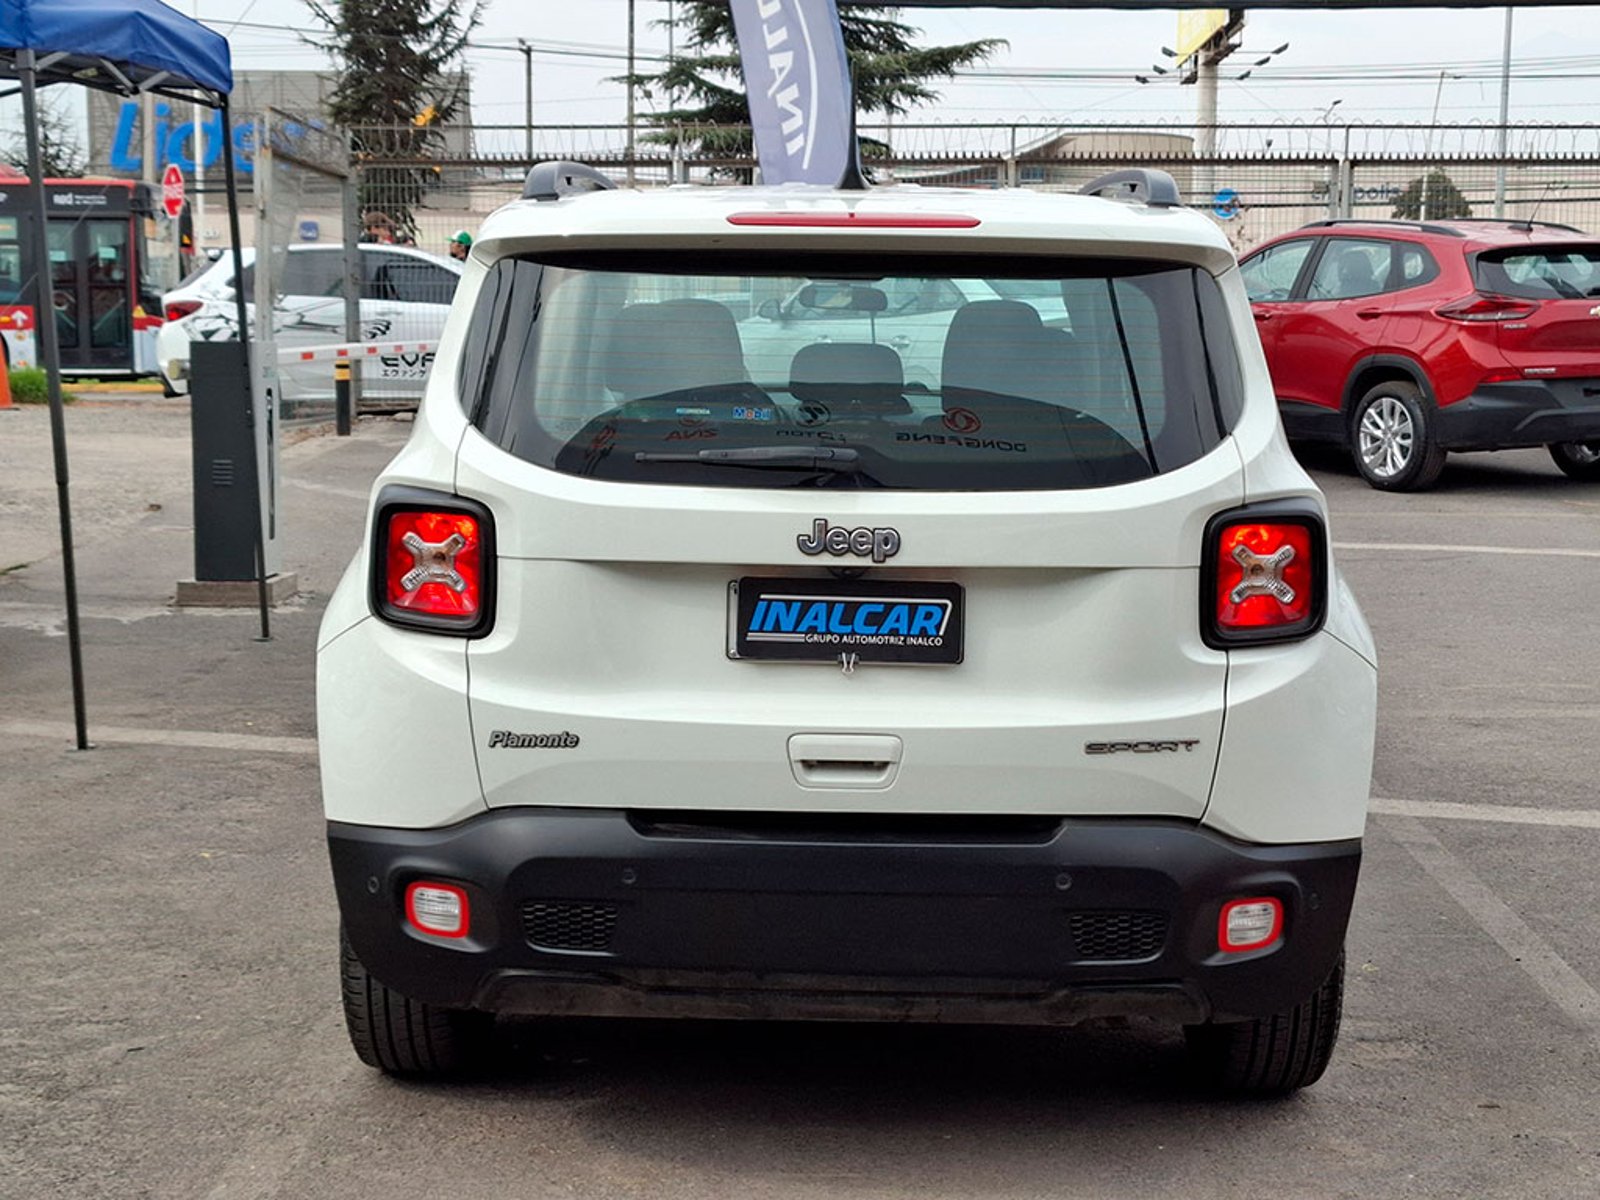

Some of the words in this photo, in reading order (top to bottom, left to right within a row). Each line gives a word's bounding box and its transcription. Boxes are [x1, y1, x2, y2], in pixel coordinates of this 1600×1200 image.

[797, 518, 901, 563] Jeep
[749, 601, 944, 636] INALCAR
[806, 633, 840, 644] GRUPO
[841, 634, 905, 646] AUTOMOTRIZ
[906, 637, 943, 647] INALCO
[488, 730, 580, 749] Piamonte
[1085, 740, 1200, 755] SPORT
